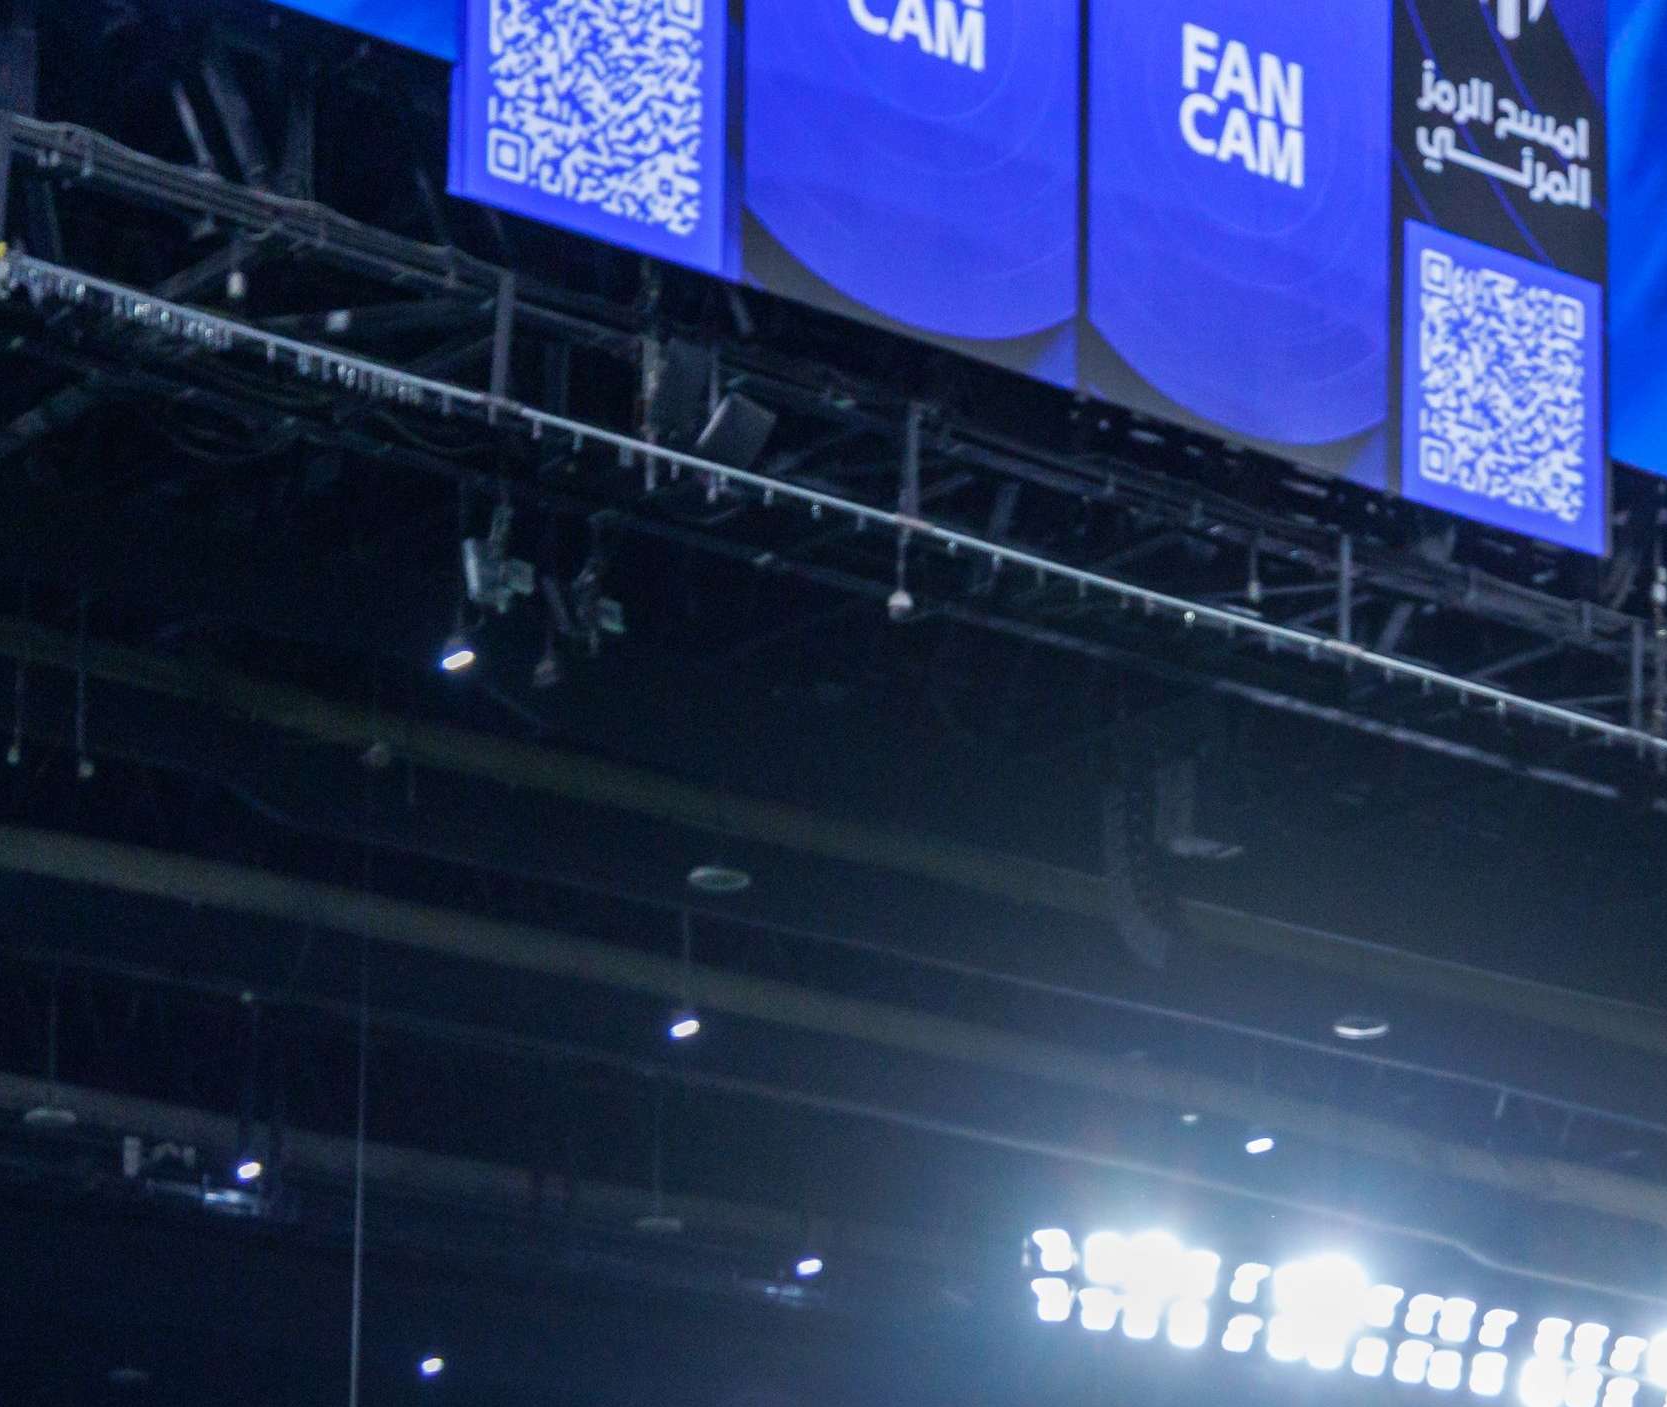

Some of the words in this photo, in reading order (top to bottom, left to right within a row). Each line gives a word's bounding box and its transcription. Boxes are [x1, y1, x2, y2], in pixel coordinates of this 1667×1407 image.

[847, 0, 986, 72] CAM
[1181, 22, 1304, 128] FAN
[1416, 58, 1494, 124] الرمز
[1179, 91, 1305, 189] CAM
[1494, 97, 1590, 160] امسح
